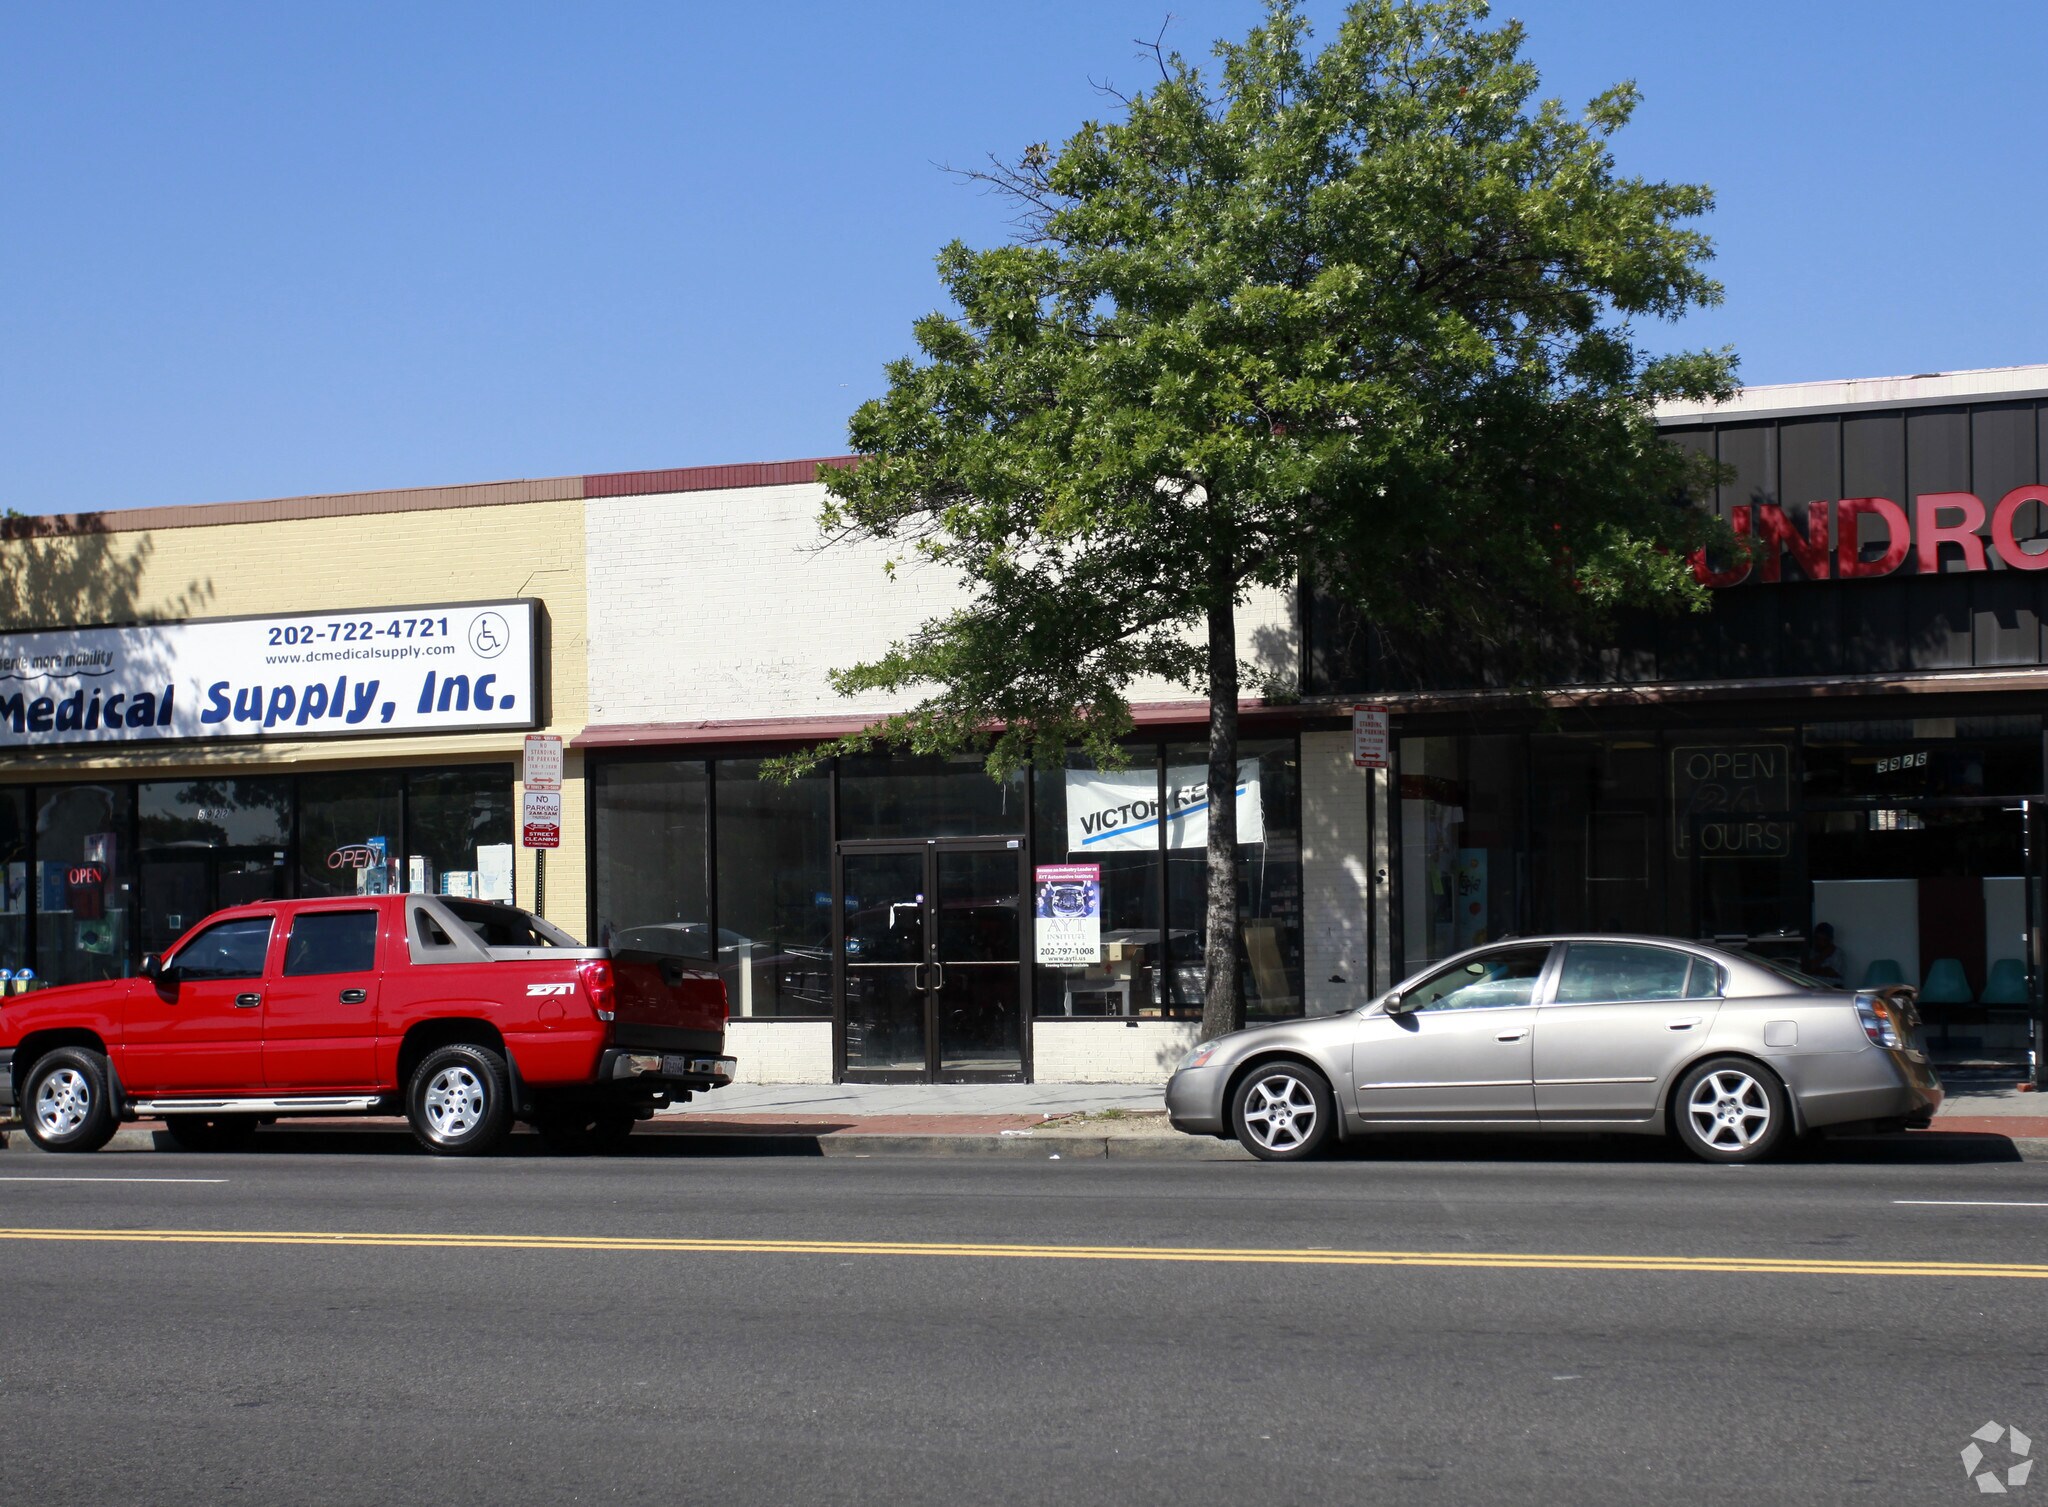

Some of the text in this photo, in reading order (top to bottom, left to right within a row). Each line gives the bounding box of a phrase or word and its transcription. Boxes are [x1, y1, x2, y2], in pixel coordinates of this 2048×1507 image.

[269, 617, 448, 646] 202-722-4721
[32, 654, 62, 669] more
[65, 651, 114, 667] mobility
[265, 644, 455, 665] www.dcmedicalsupply.com
[0, 670, 515, 733] Medical Supply, Inc.
[536, 755, 560, 763] PARKING
[1687, 753, 1774, 780] OPEN
[1878, 752, 1927, 773] 5926
[535, 796, 549, 804] NO
[198, 809, 228, 820] 5922
[326, 848, 382, 869] OPEN
[69, 868, 101, 885] OPEN
[1040, 947, 1095, 955] 202-797-1008
[526, 983, 575, 996] Z71
